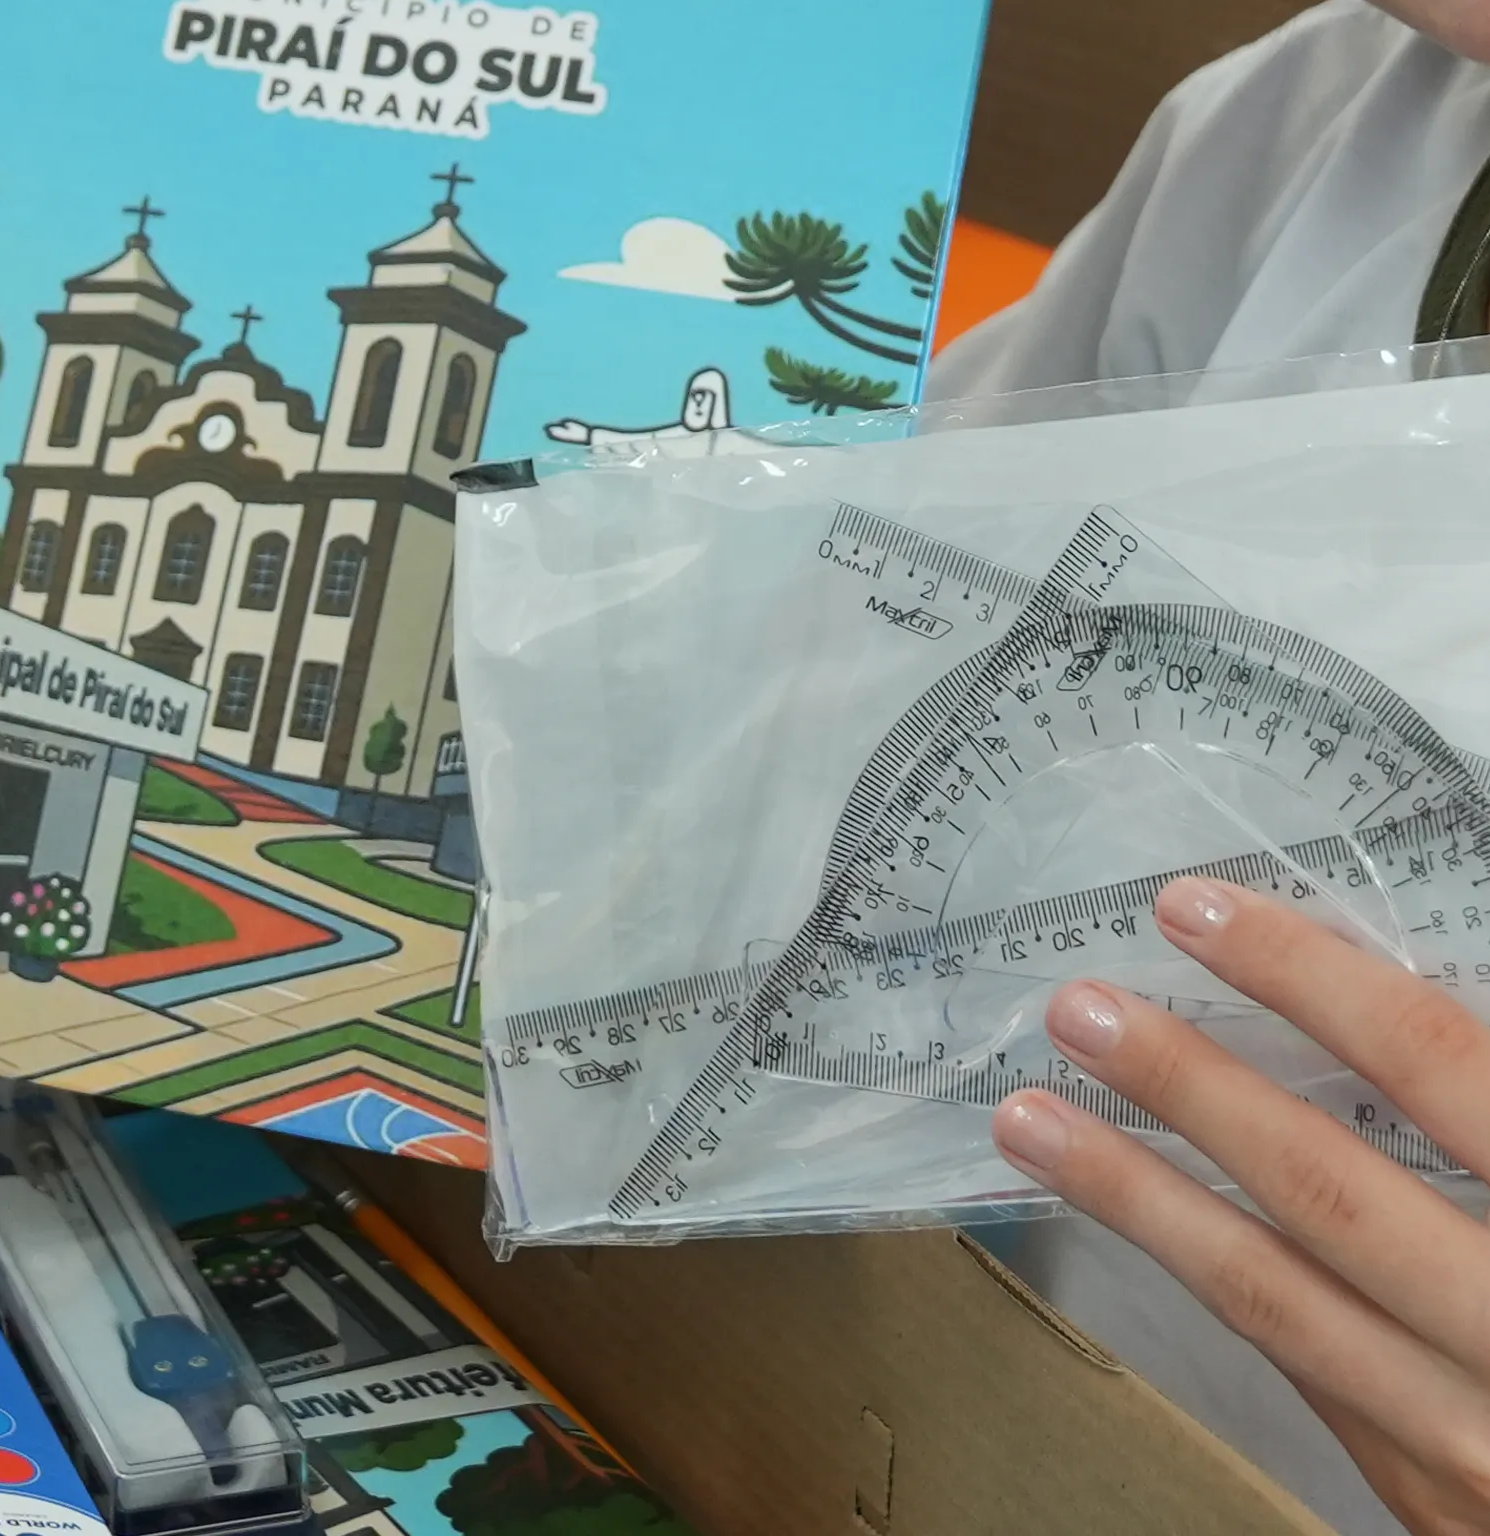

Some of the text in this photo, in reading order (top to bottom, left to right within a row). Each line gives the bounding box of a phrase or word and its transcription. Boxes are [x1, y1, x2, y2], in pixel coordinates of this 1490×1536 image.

[531, 15, 589, 41] DE
[174, 9, 597, 104] PIRAÍ DO SUL
[268, 77, 478, 130] PARANÁ
[920, 581, 934, 600] 2
[976, 603, 990, 621] 3
[47, 657, 76, 706] de
[82, 666, 130, 724] Piraí
[130, 689, 154, 724] do
[156, 700, 188, 736] Sul
[6, 1516, 82, 1531] WORLD
